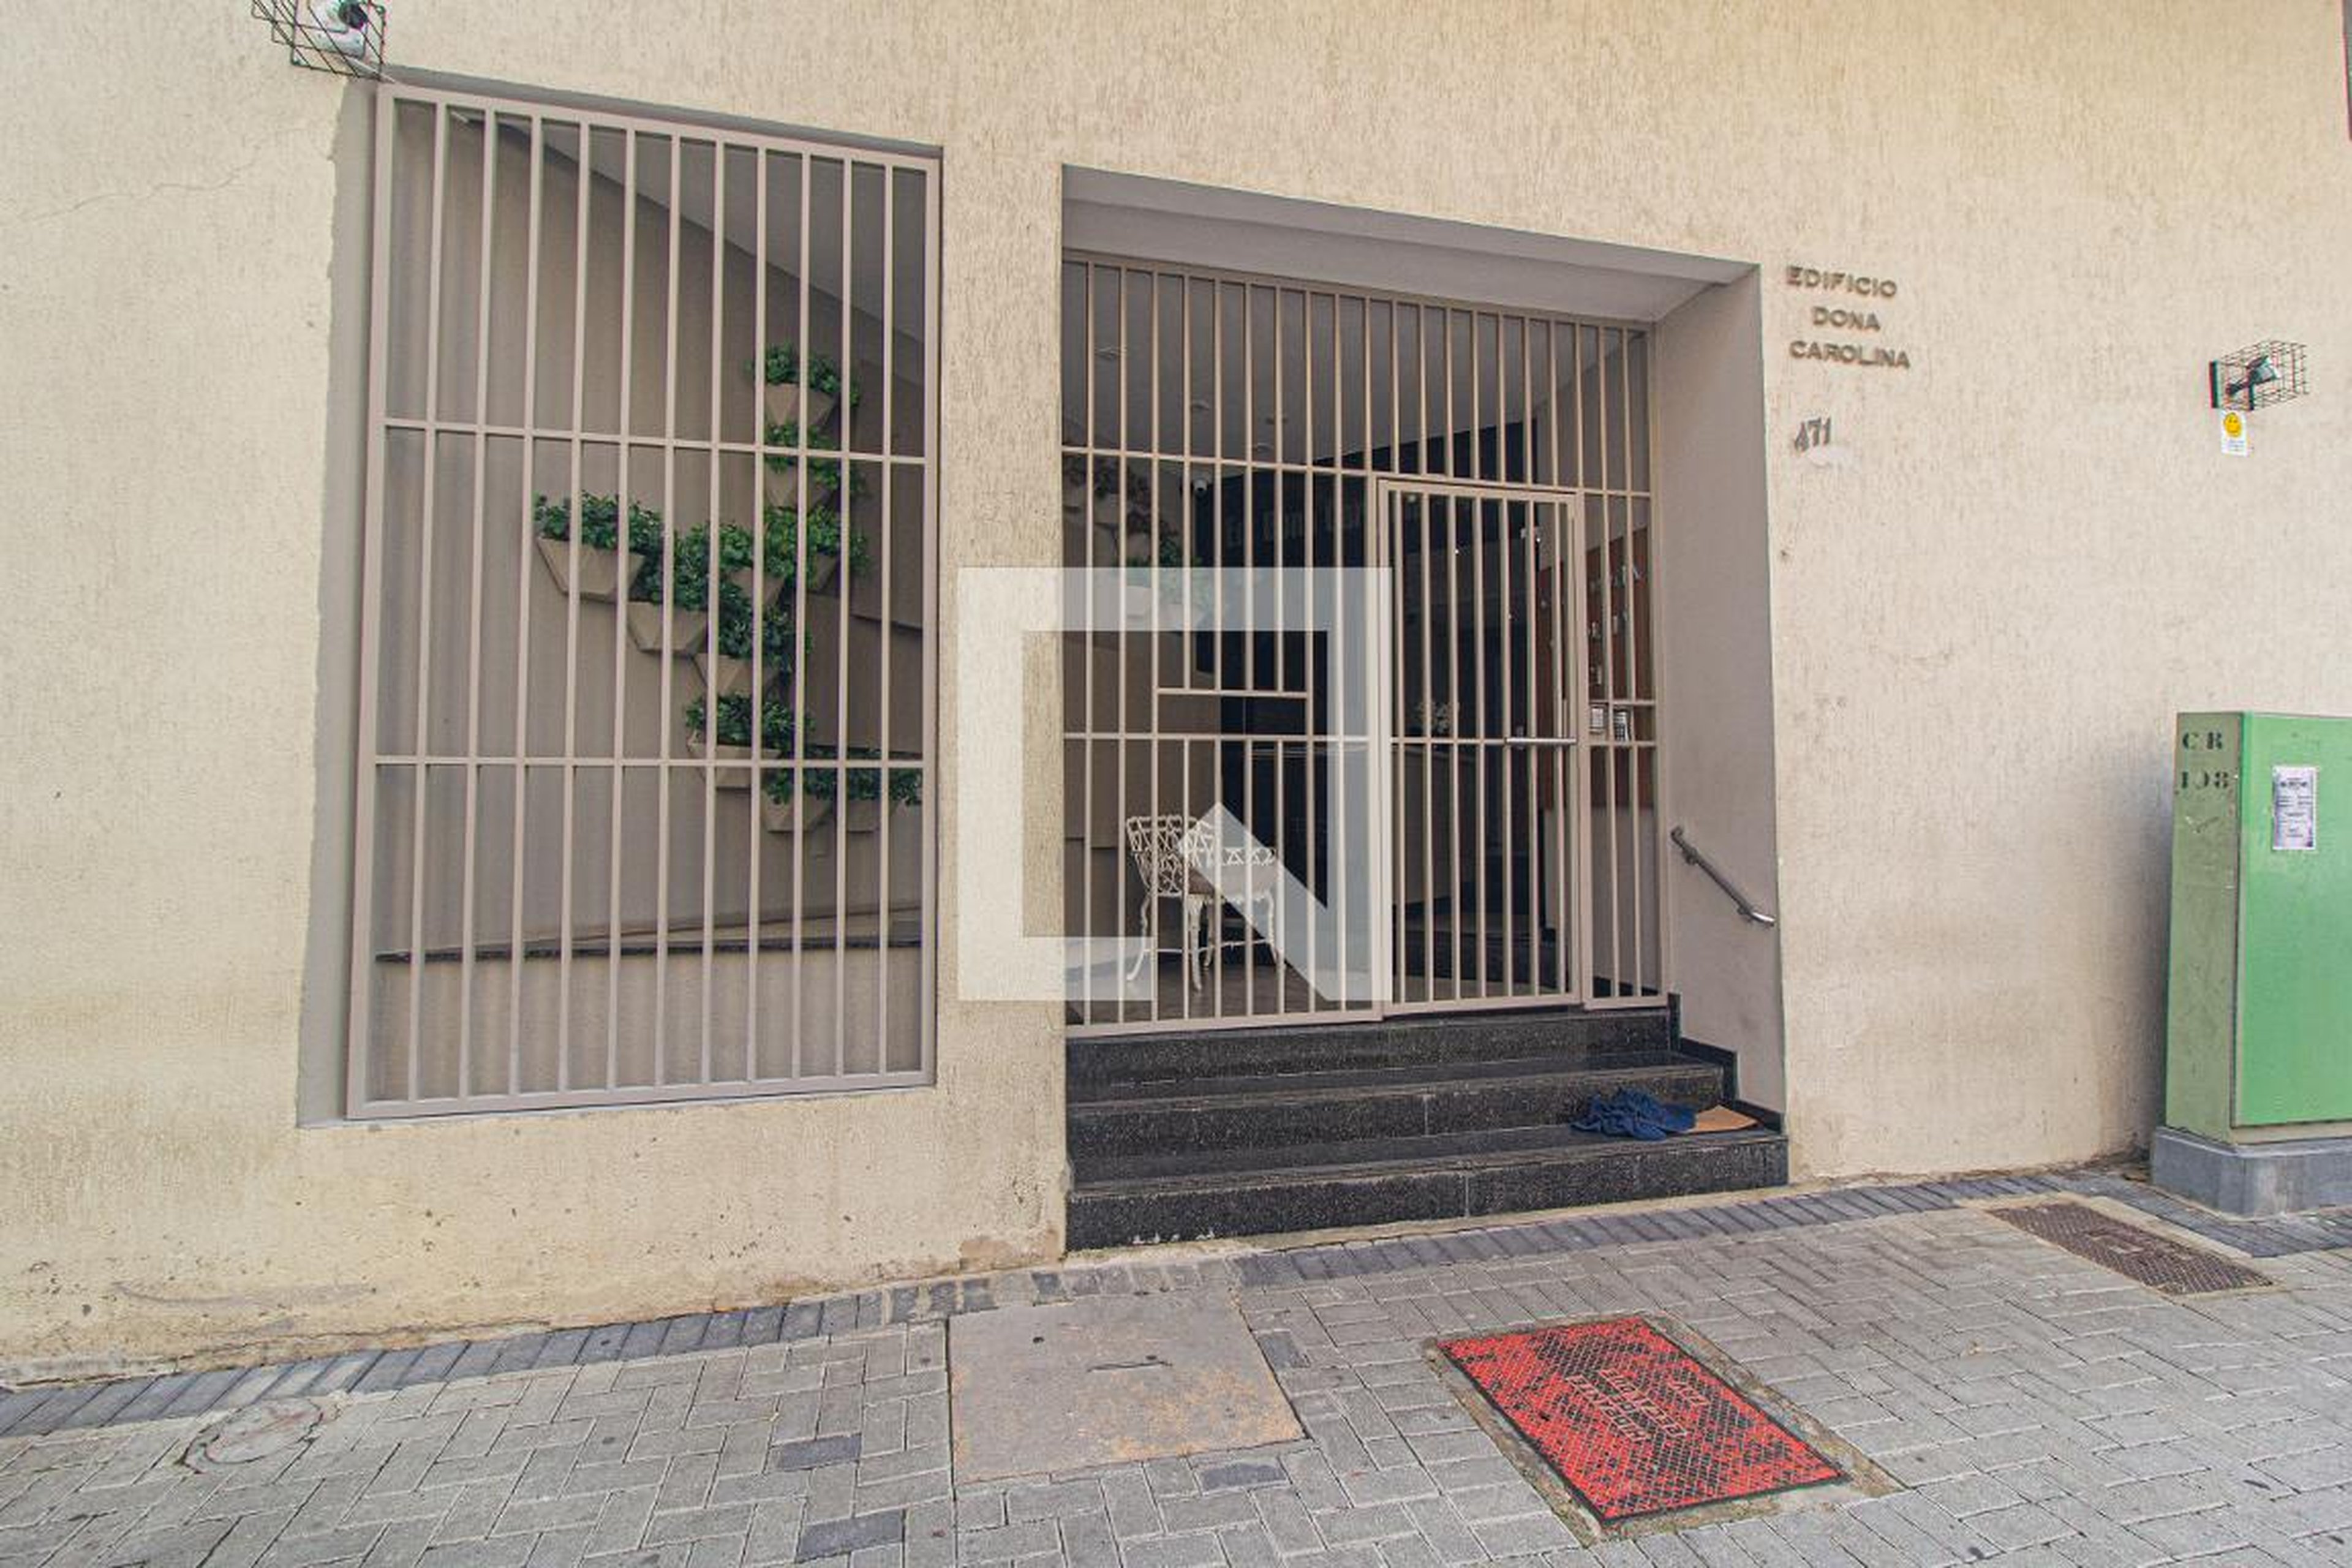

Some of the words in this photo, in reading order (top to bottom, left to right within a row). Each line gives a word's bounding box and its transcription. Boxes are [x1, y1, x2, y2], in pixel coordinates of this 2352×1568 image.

[1787, 265, 1898, 298] EDIFICIO
[1813, 306, 1881, 331] DONA
[1789, 341, 1910, 369] CAROLINA
[2182, 732, 2223, 749] CR
